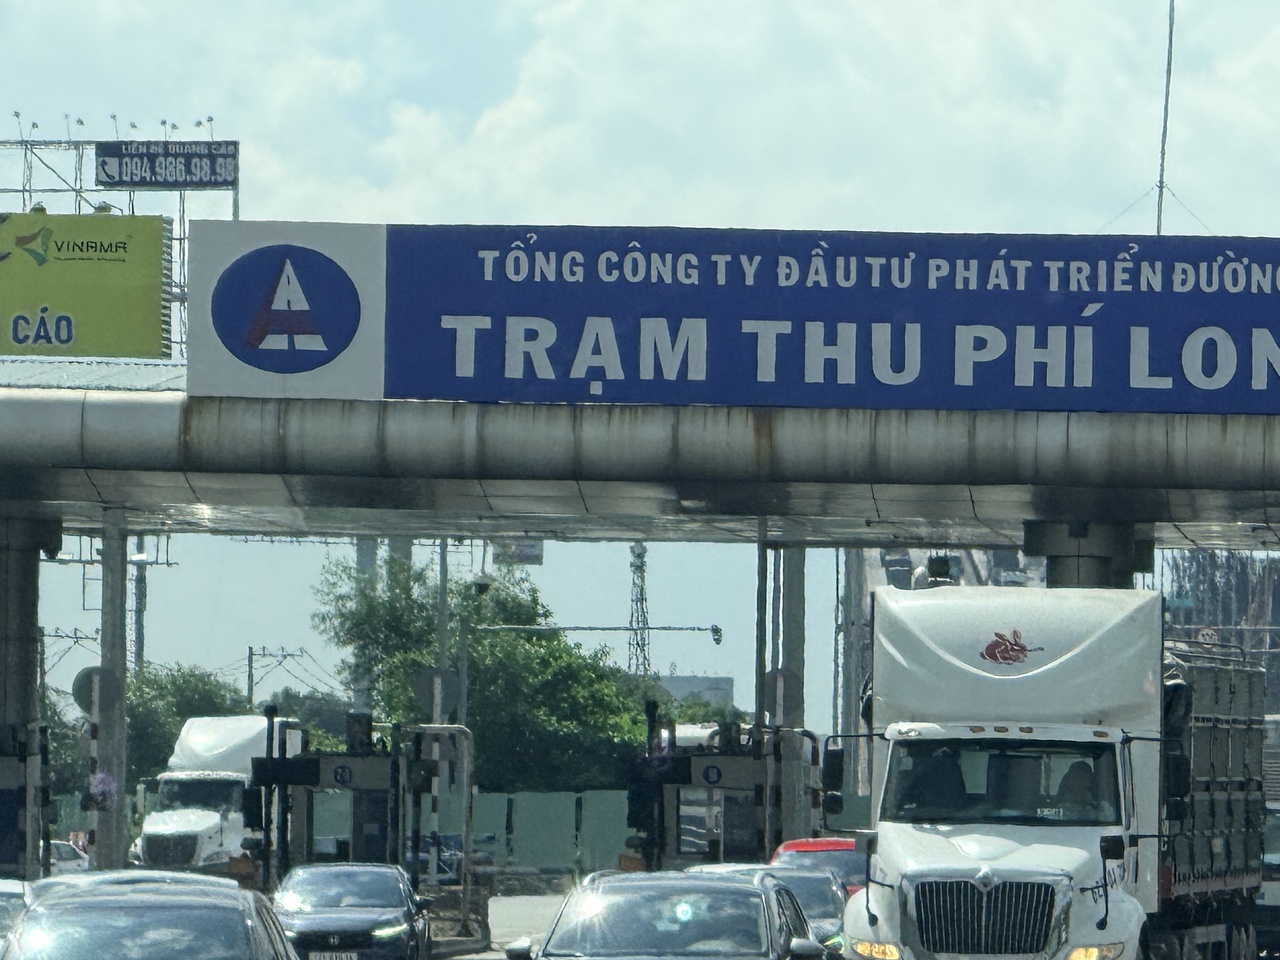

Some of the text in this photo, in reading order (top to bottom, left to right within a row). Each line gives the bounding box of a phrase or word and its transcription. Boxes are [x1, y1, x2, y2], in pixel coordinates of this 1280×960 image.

[478, 233, 584, 283] TỔNG
[597, 241, 699, 285] CÔNG
[710, 253, 761, 287] TY
[777, 241, 857, 288] ĐẦU
[869, 252, 914, 289] TƯ
[927, 248, 1033, 291] PHÁT
[1043, 243, 1163, 292] TRIỂN
[12, 306, 73, 344] CÁO
[441, 315, 707, 395] TRẠM
[741, 320, 921, 387] THU
[953, 302, 1104, 388] PHÍ
